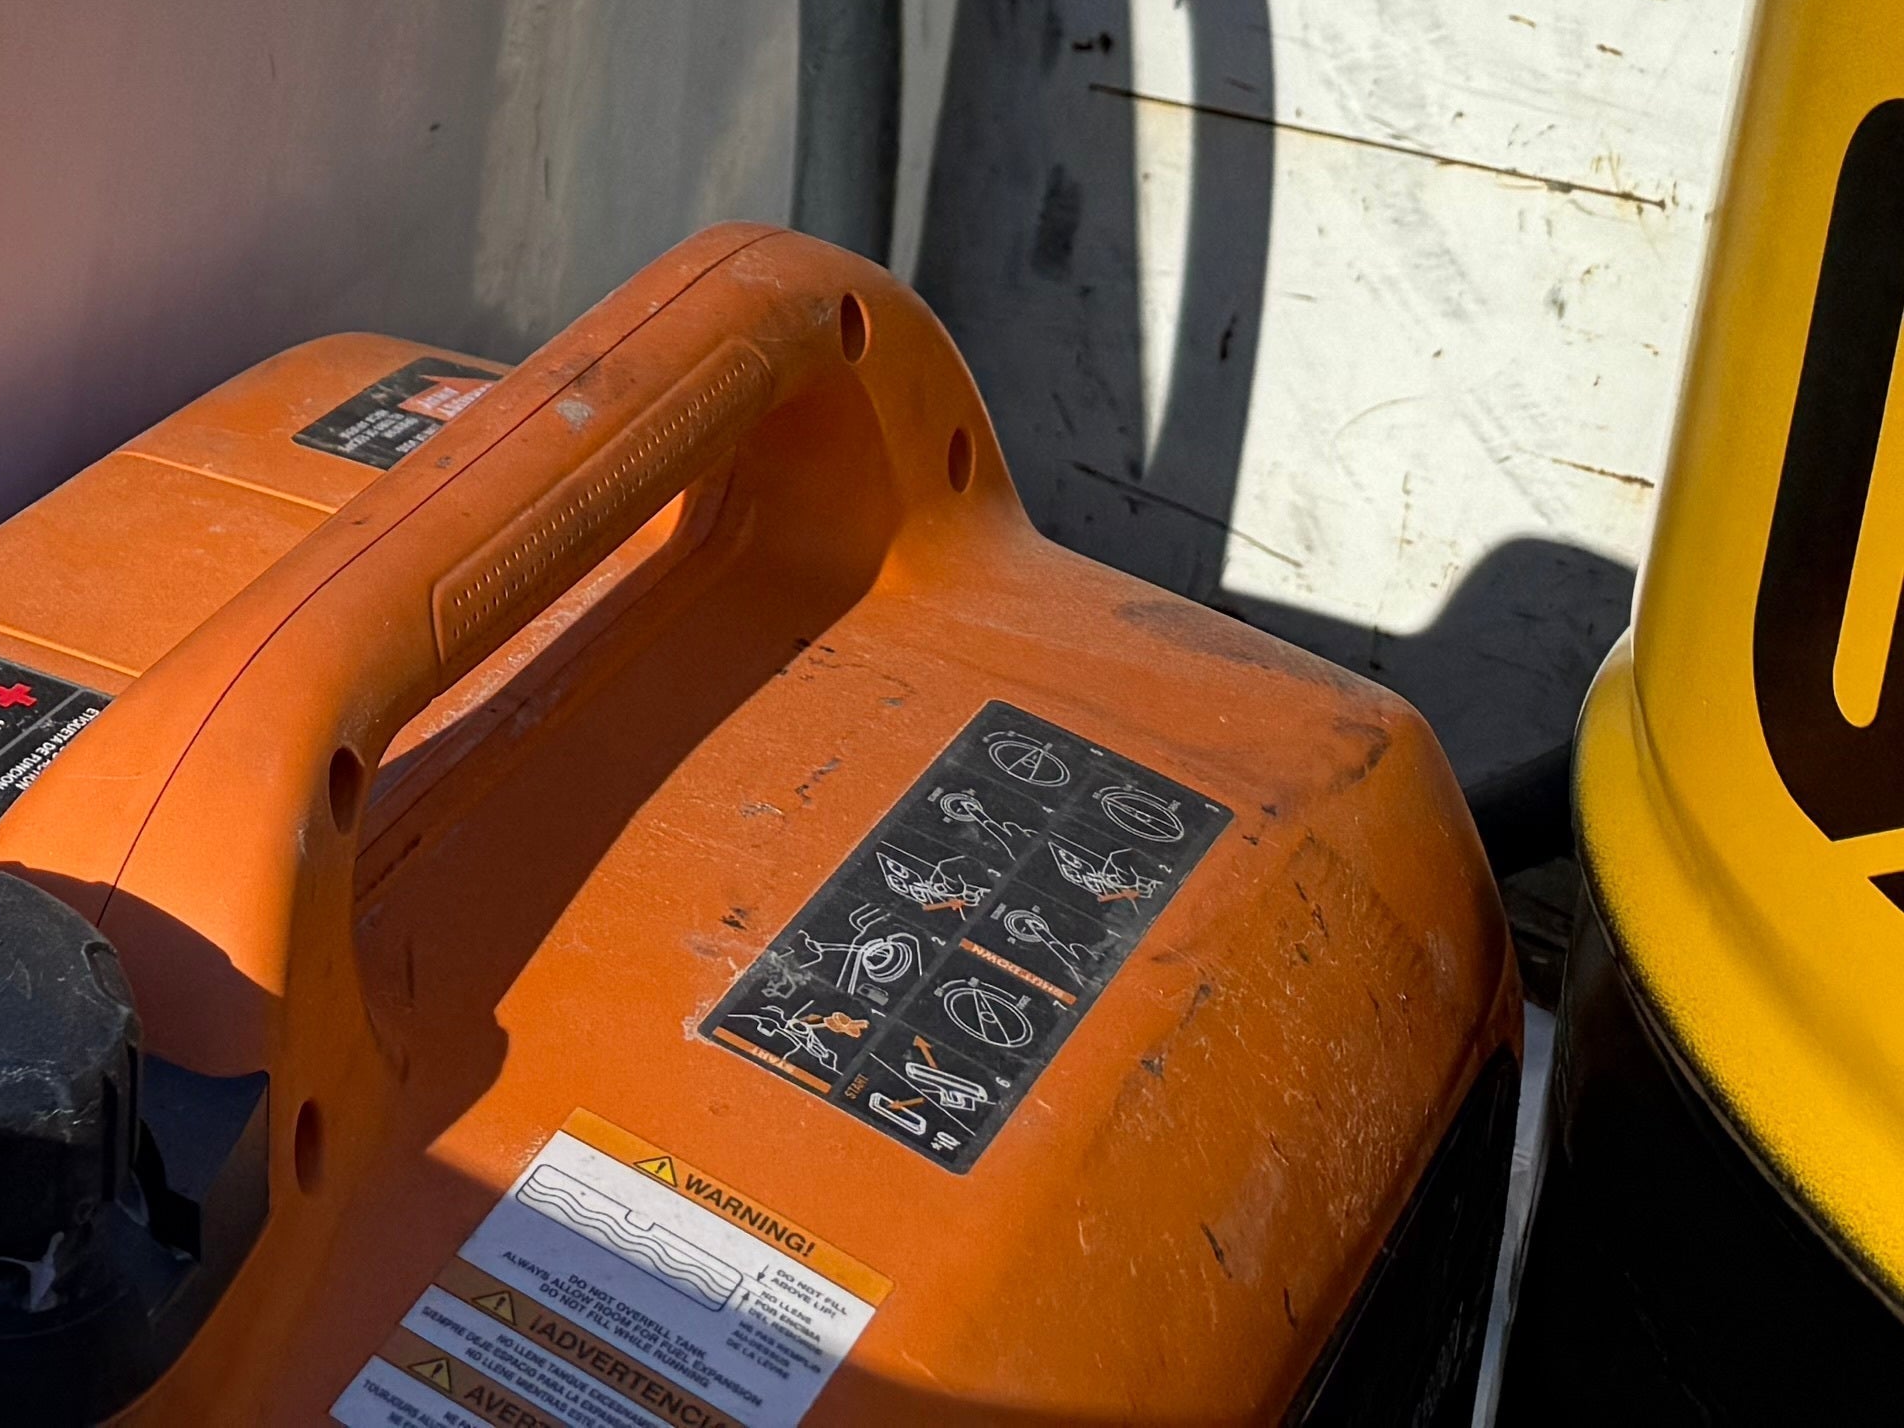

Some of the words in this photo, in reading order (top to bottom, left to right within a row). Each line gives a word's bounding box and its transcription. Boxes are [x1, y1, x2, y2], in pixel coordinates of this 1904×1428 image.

[49, 707, 100, 744] ETIQUETA
[34, 742, 55, 755] DE
[843, 1073, 870, 1099] START
[679, 1173, 816, 1257] WARNING!
[759, 1290, 778, 1304] NO
[778, 1301, 813, 1324] LLENE
[770, 1276, 812, 1303] ABOVE
[812, 1300, 837, 1318] LIP!
[775, 1268, 795, 1283] DO
[796, 1280, 823, 1299] NOT
[822, 1296, 849, 1315] FILL
[501, 1248, 551, 1281] ALWAYS
[549, 1276, 594, 1306] ALLOW
[592, 1301, 632, 1328] ROOM
[631, 1324, 660, 1344] FOR
[658, 1339, 692, 1363] FUEL
[691, 1359, 764, 1407] EXPANSION
[538, 1282, 559, 1298] DO
[558, 1294, 586, 1314] NOT
[585, 1310, 613, 1330] FILL
[612, 1326, 653, 1353] WHILE
[651, 1349, 712, 1388] RUNNING
[567, 1273, 589, 1290] DO
[587, 1285, 616, 1305] NOT
[614, 1301, 674, 1340] OVERFILL
[672, 1335, 708, 1360] TANK
